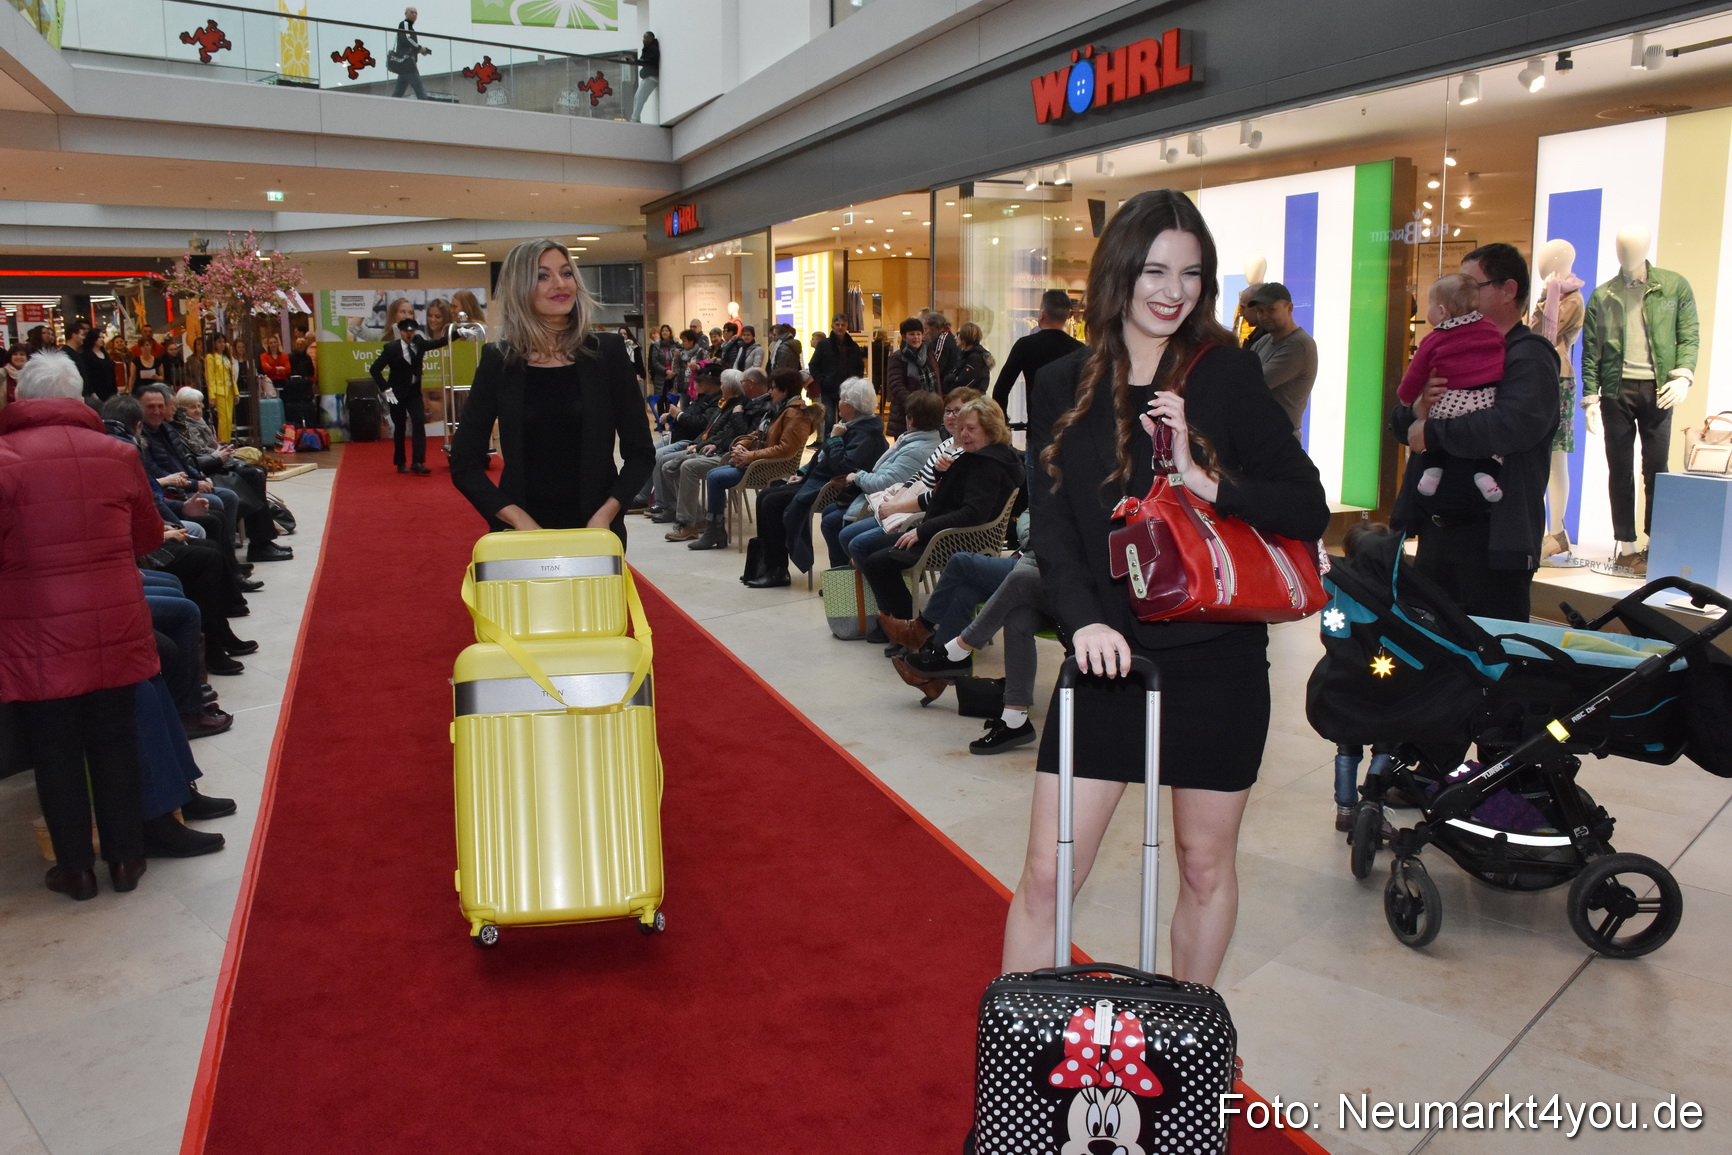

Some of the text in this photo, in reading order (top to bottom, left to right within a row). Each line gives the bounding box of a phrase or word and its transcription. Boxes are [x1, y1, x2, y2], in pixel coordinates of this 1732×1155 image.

[1031, 27, 1193, 125] WÖHRL
[663, 203, 698, 238] WÖHRL
[352, 349, 373, 360] Von
[1573, 557, 1602, 570] GERRY
[541, 689, 564, 697] TIN
[1571, 710, 1587, 723] ABC
